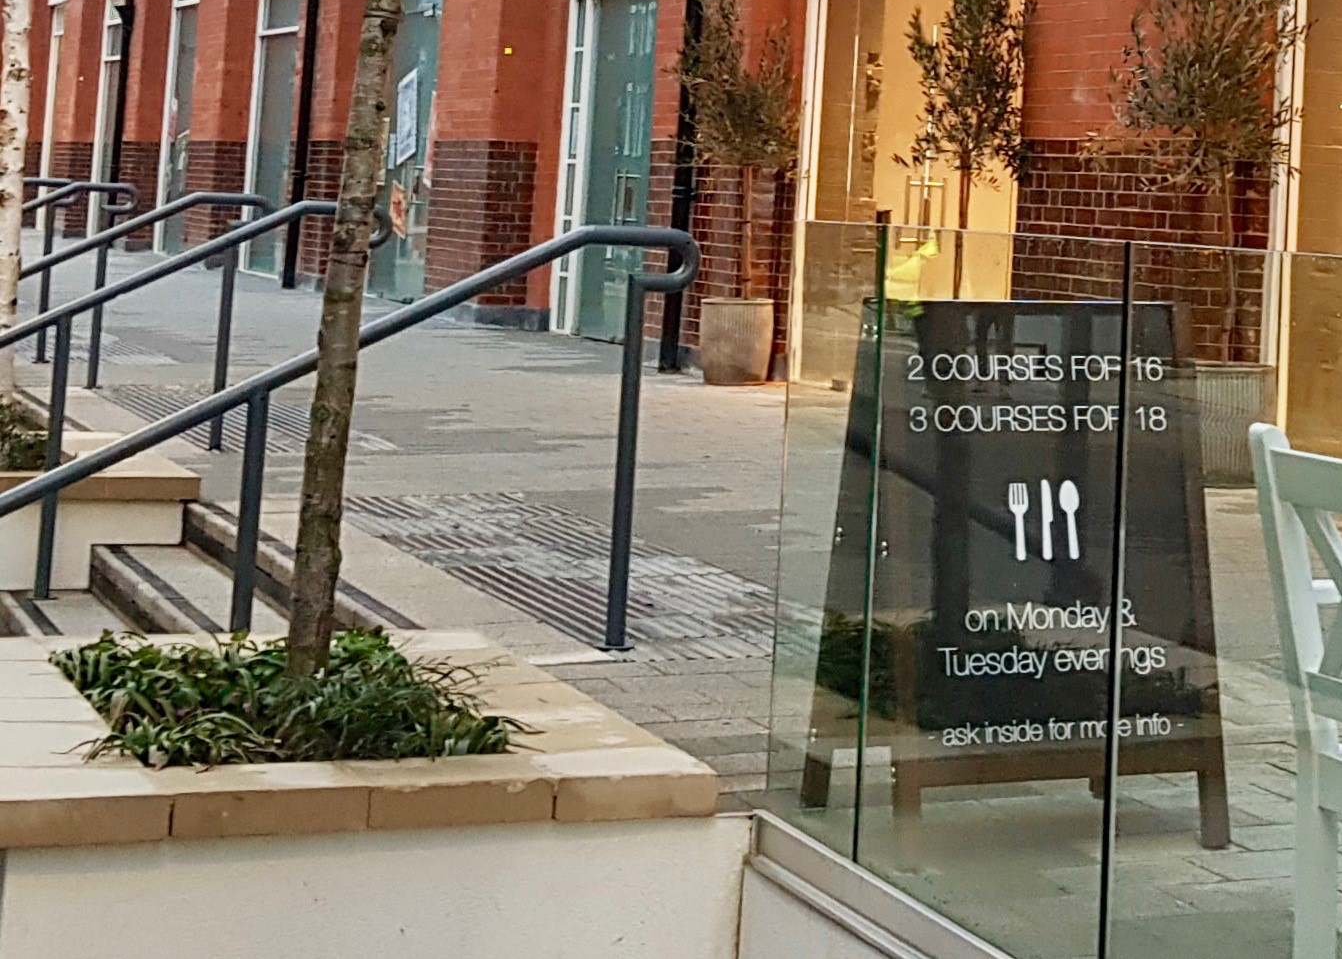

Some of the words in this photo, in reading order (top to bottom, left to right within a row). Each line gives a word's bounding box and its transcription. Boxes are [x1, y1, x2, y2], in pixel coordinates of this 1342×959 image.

[908, 355, 925, 381] 2
[931, 354, 1064, 381] COURSES
[1131, 356, 1164, 381] 16
[909, 406, 927, 432] 3
[934, 405, 1067, 432] COURSES
[1134, 407, 1167, 431] 18
[965, 609, 999, 632] on
[1006, 600, 1111, 633] Monday
[937, 645, 1047, 679] Tuesday
[1054, 646, 1166, 675] evenngs
[942, 722, 980, 746] ask
[985, 720, 1043, 743] inside
[1048, 716, 1073, 740] for
[1080, 720, 1131, 738] moe
[1136, 713, 1171, 736] info
